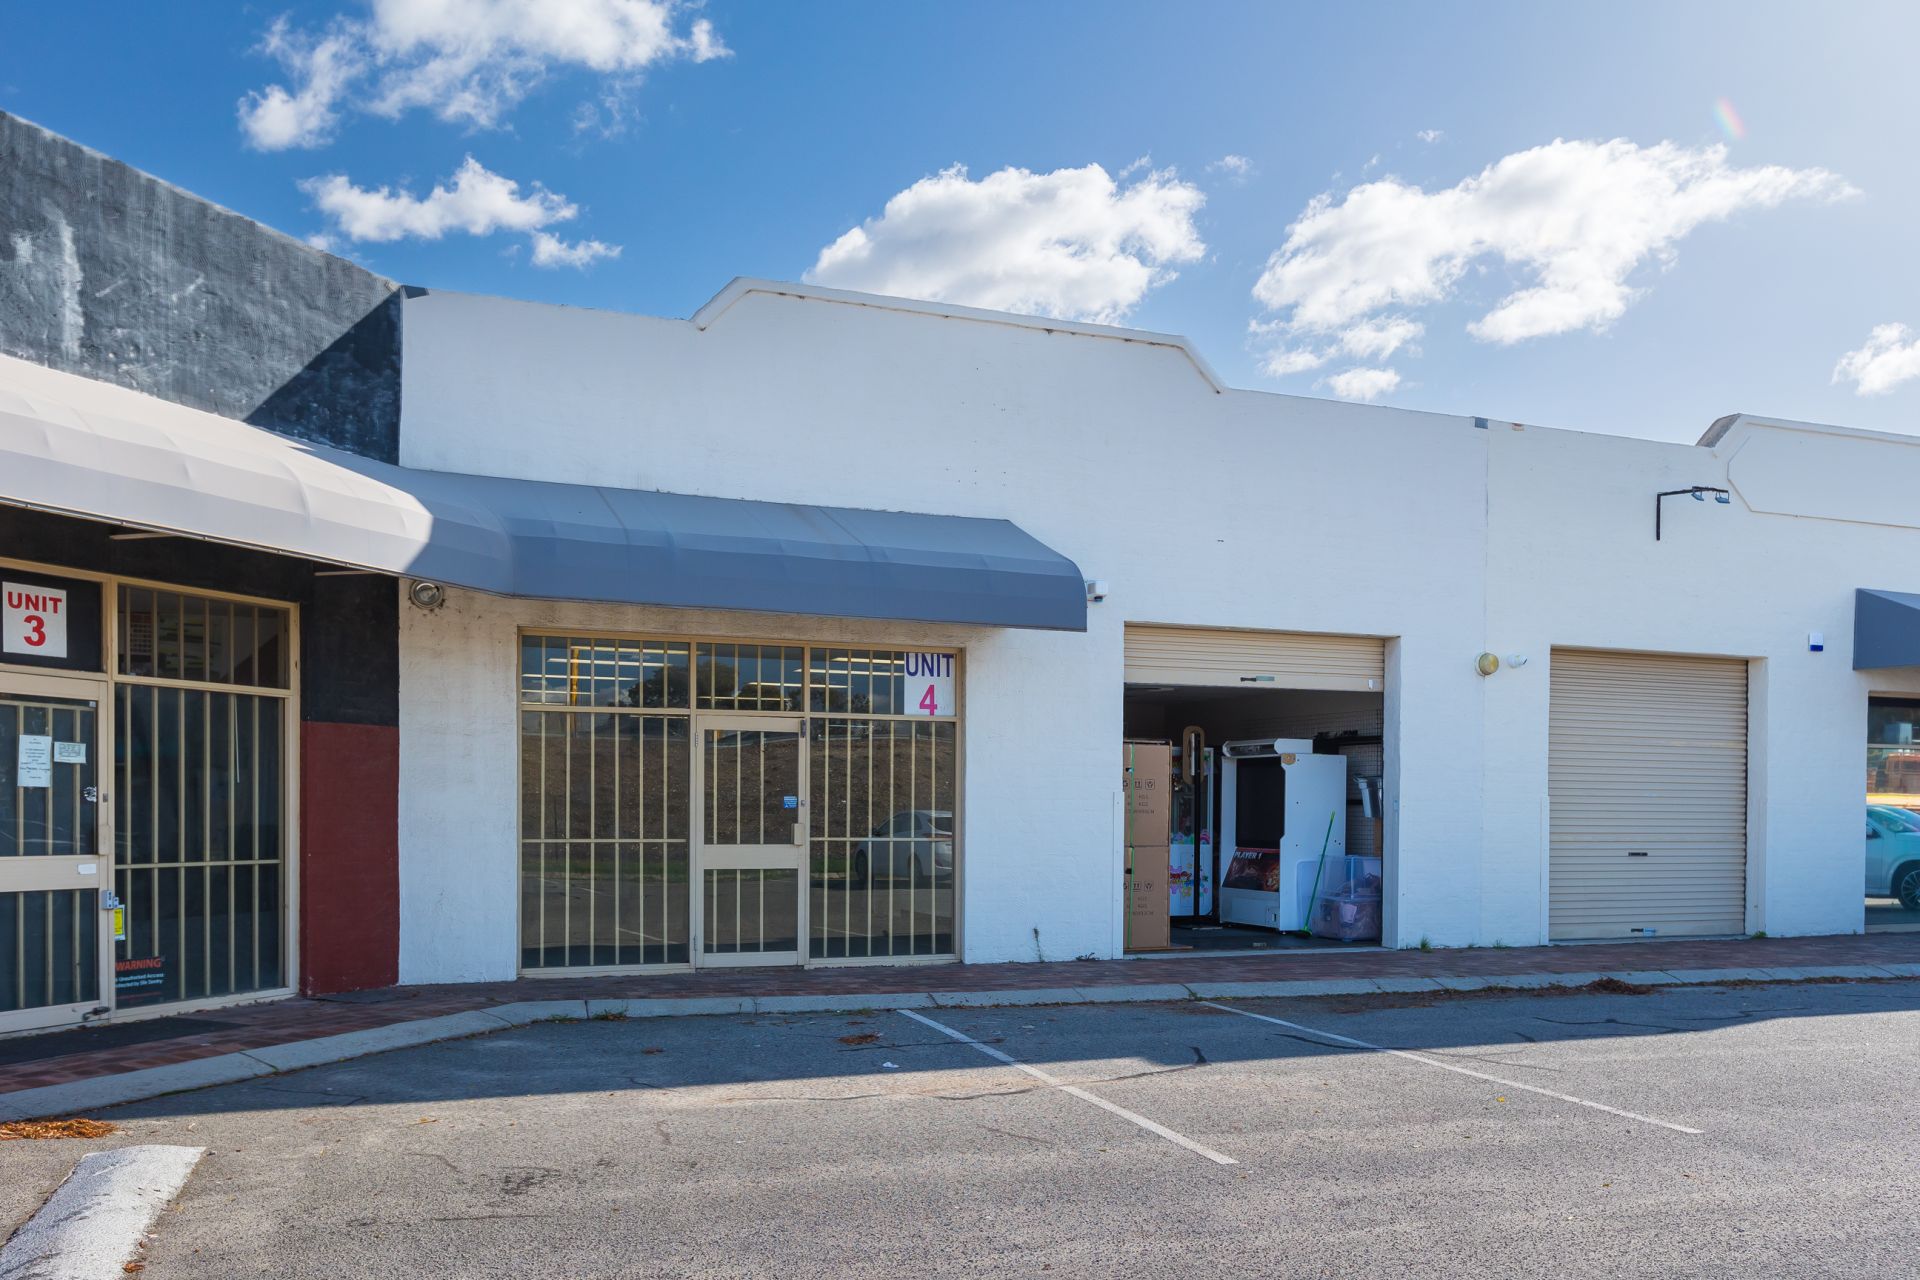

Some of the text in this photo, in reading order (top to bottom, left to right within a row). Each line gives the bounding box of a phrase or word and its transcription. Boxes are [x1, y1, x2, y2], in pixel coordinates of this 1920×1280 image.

[8, 591, 62, 614] UNIT
[23, 614, 47, 647] 3
[905, 653, 954, 677] UNIT
[919, 684, 938, 716] 4
[1233, 851, 1257, 860] PLAYER
[115, 958, 161, 971] WARNING
